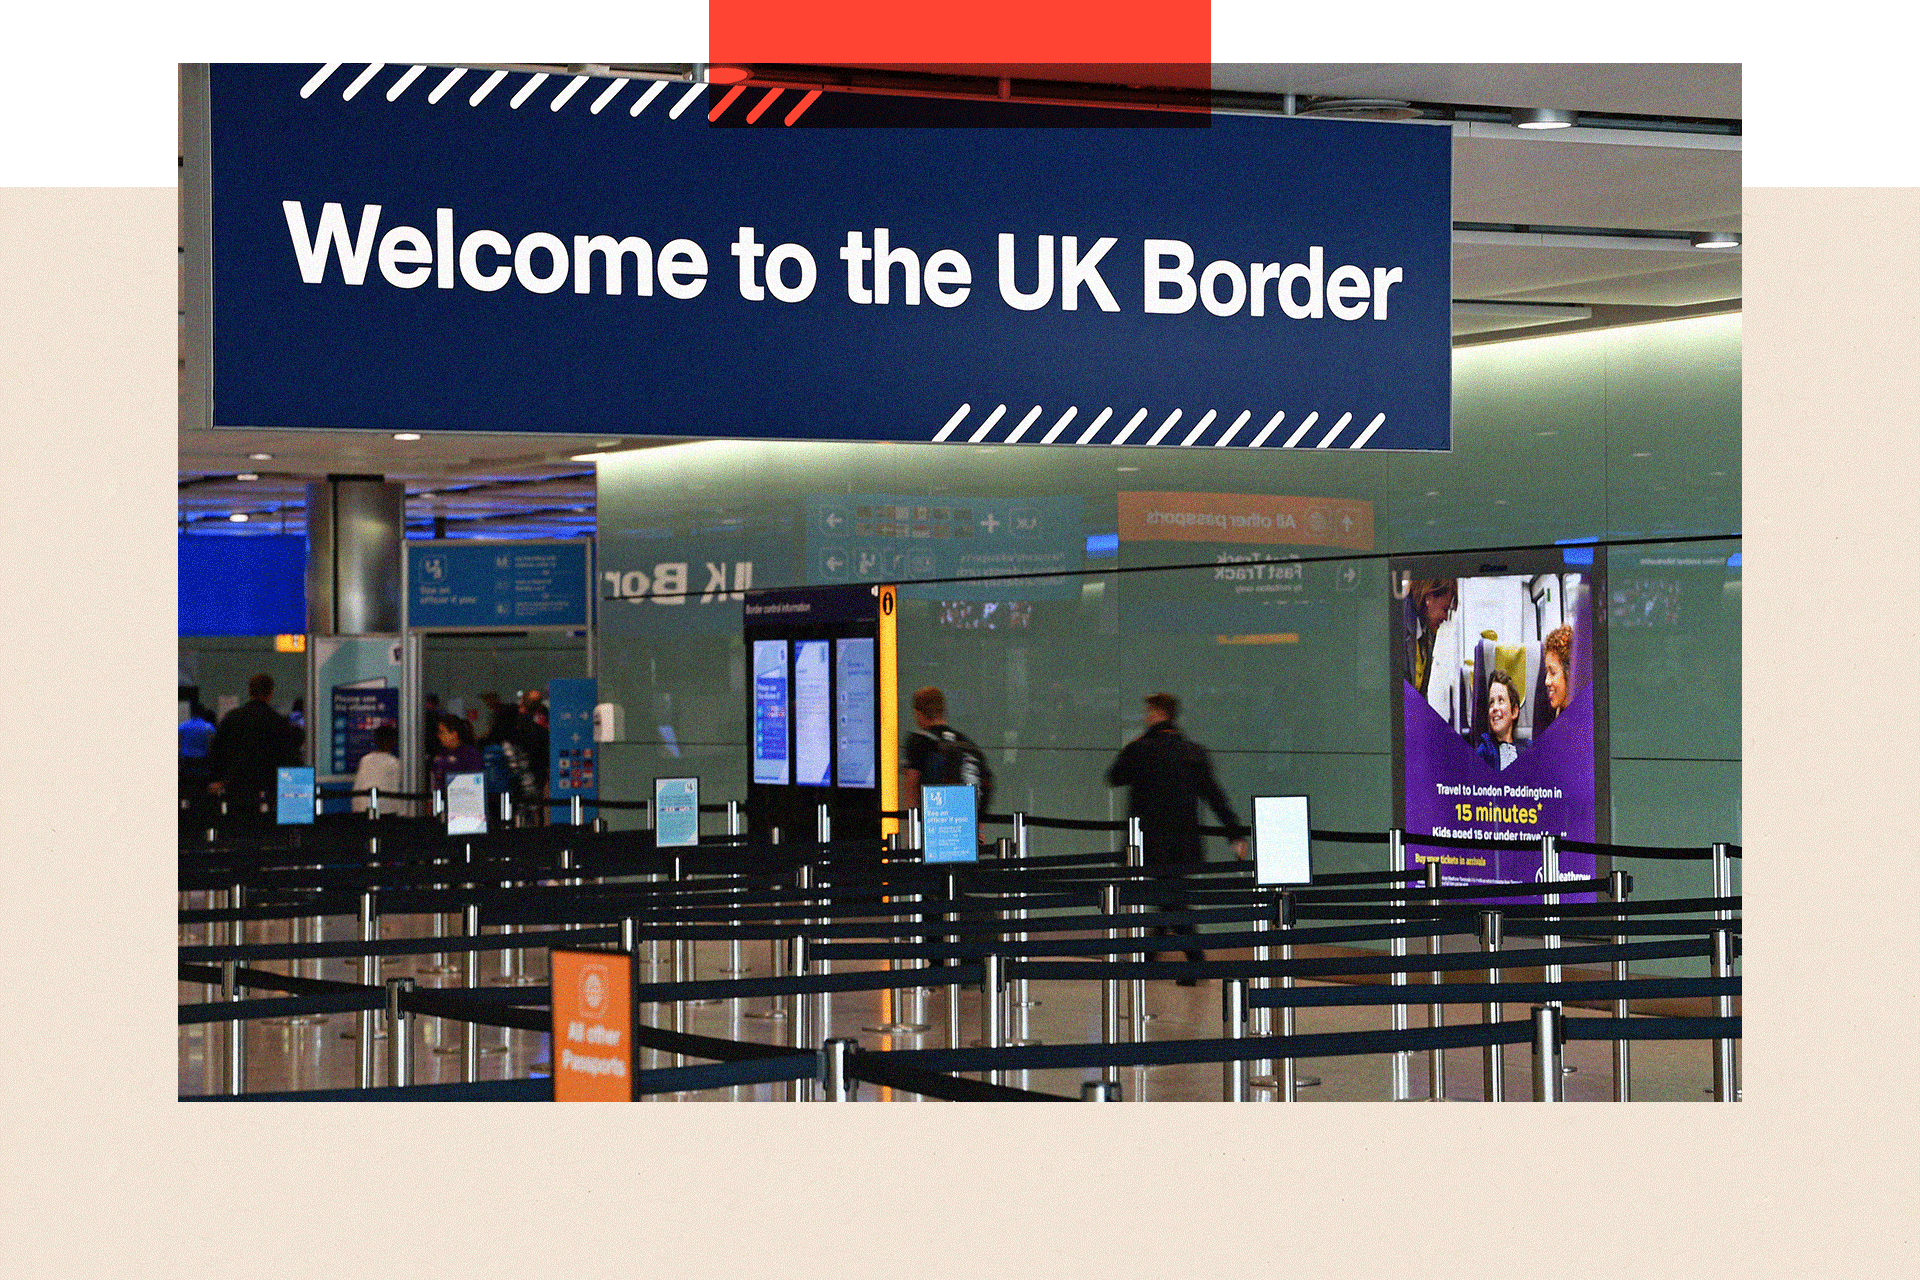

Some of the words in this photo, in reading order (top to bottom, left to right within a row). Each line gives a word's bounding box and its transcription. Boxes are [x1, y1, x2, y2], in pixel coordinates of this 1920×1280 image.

[282, 199, 709, 300] Welcome
[731, 226, 818, 303] to
[839, 227, 973, 308] the
[998, 232, 1122, 313] UK
[1144, 238, 1403, 321] Border
[1436, 783, 1462, 796] Travel
[1462, 784, 1472, 796] to
[1473, 785, 1502, 797] London
[1503, 785, 1553, 801] Paddington
[1554, 786, 1563, 799] in
[1455, 803, 1473, 822] 15
[1432, 826, 1452, 839] Kids
[1474, 829, 1483, 840] 15
[1484, 831, 1493, 840] or
[1494, 829, 1519, 841] under
[1557, 870, 1591, 881] eathrow
